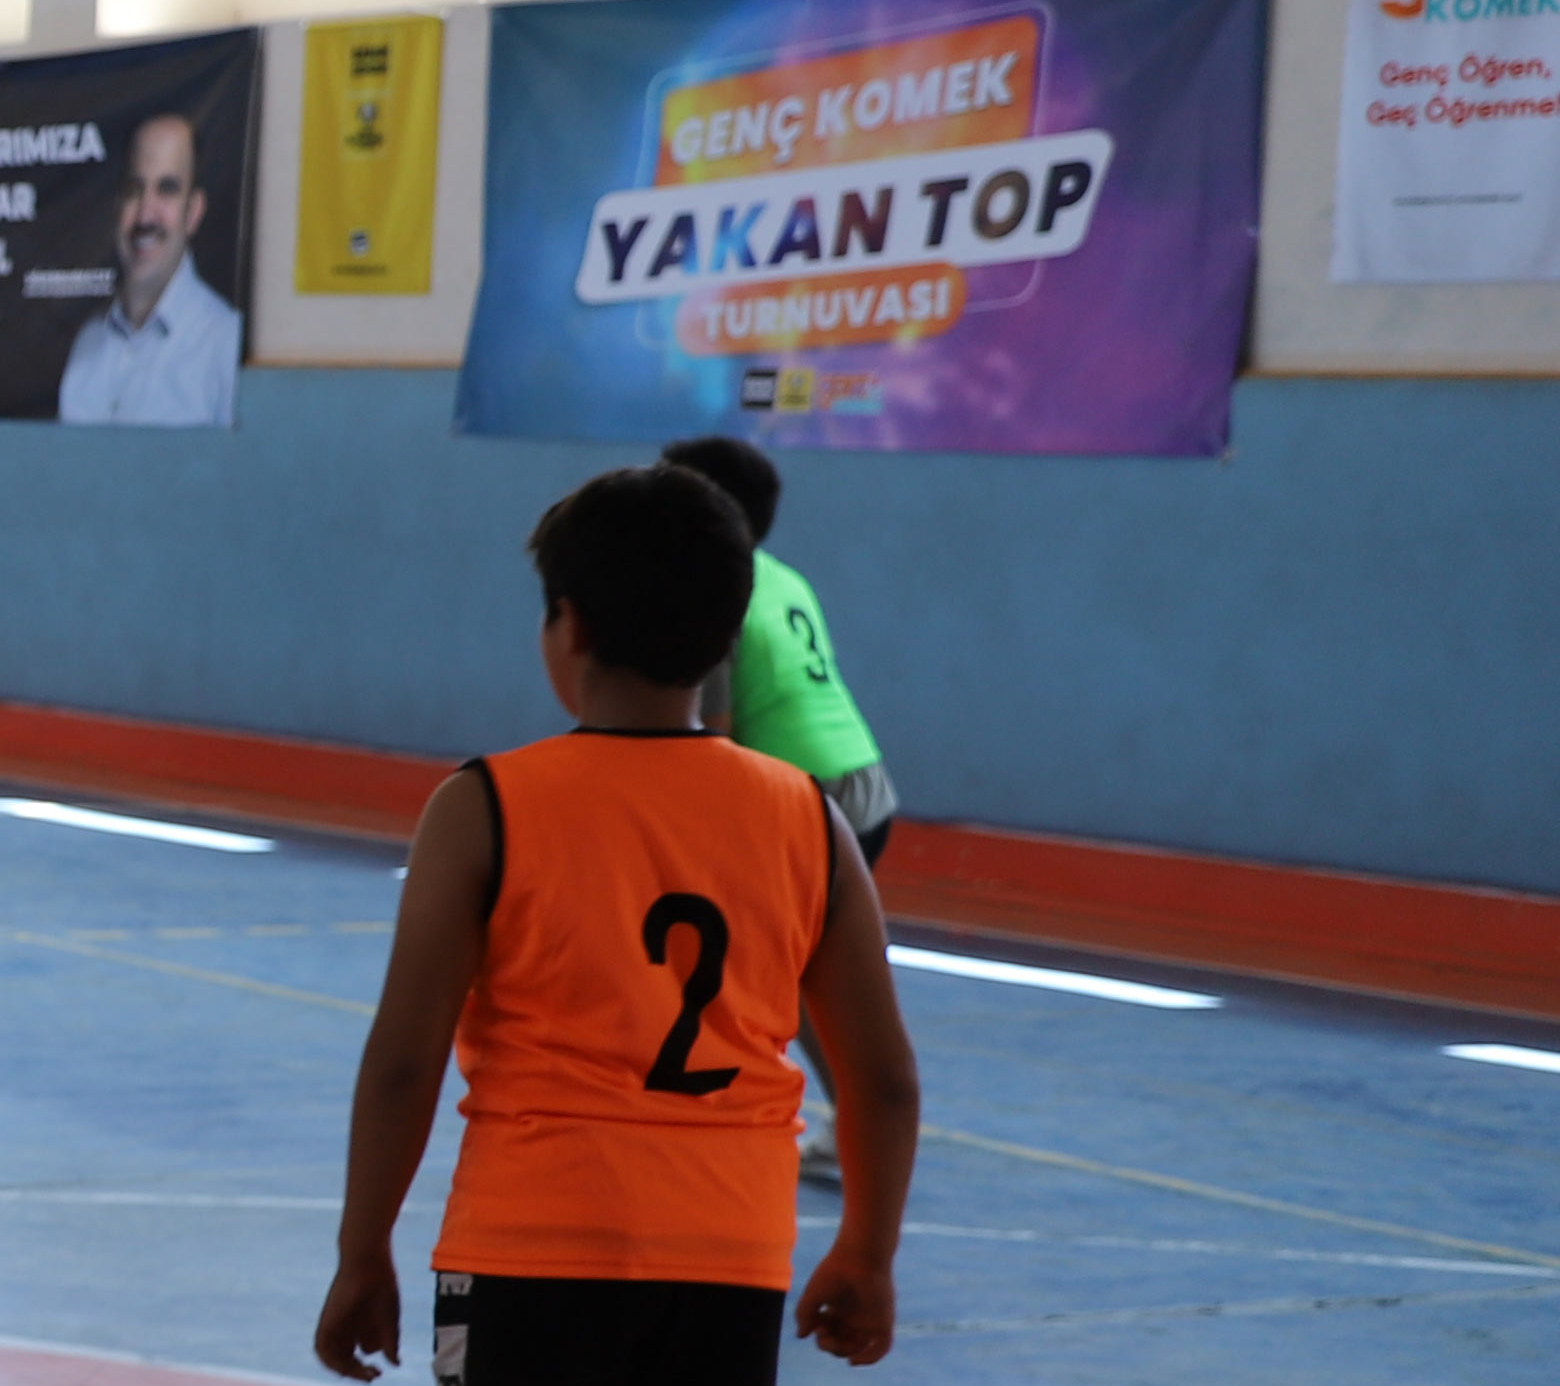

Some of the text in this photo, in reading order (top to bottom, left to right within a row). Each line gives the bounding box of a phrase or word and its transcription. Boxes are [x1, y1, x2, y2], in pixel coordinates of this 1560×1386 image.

[670, 52, 1018, 163] GENÇ KOMEK
[1379, 60, 1449, 90] Genç
[1366, 100, 1417, 128] Geç
[601, 161, 1094, 283] YAKAN TOP
[703, 277, 953, 340] TURNUVASI
[787, 607, 829, 683] 3
[642, 892, 740, 1095] 2
